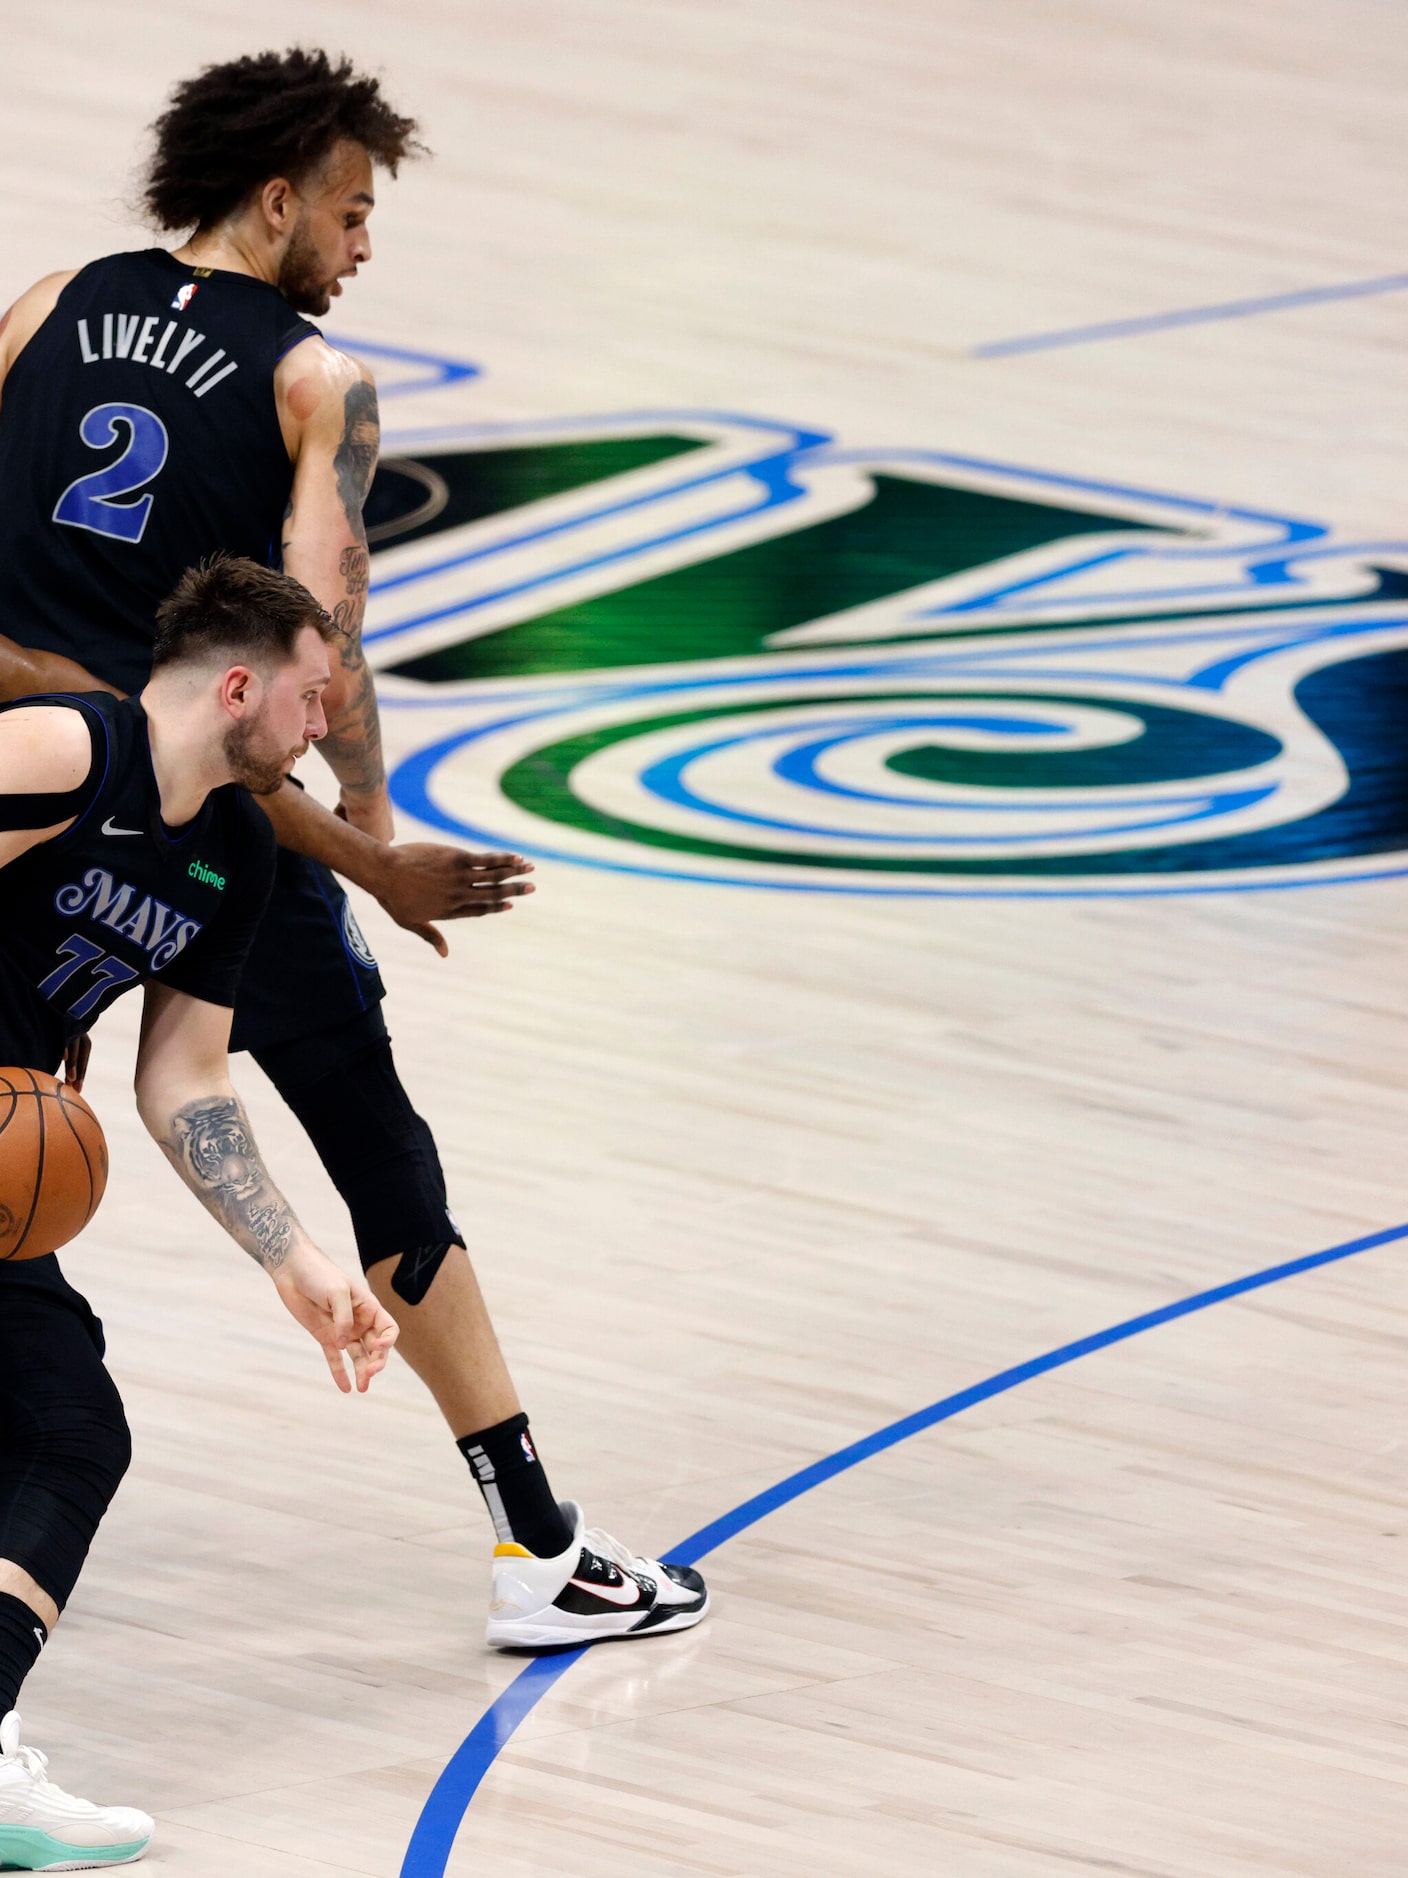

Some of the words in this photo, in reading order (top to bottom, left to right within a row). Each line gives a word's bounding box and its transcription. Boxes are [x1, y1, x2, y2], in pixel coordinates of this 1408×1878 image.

[77, 313, 206, 374] LIVELY
[185, 348, 238, 398] II
[52, 402, 169, 544] 2
[188, 860, 226, 891] chime
[54, 867, 203, 973] MAVS
[37, 933, 140, 1020] 77
